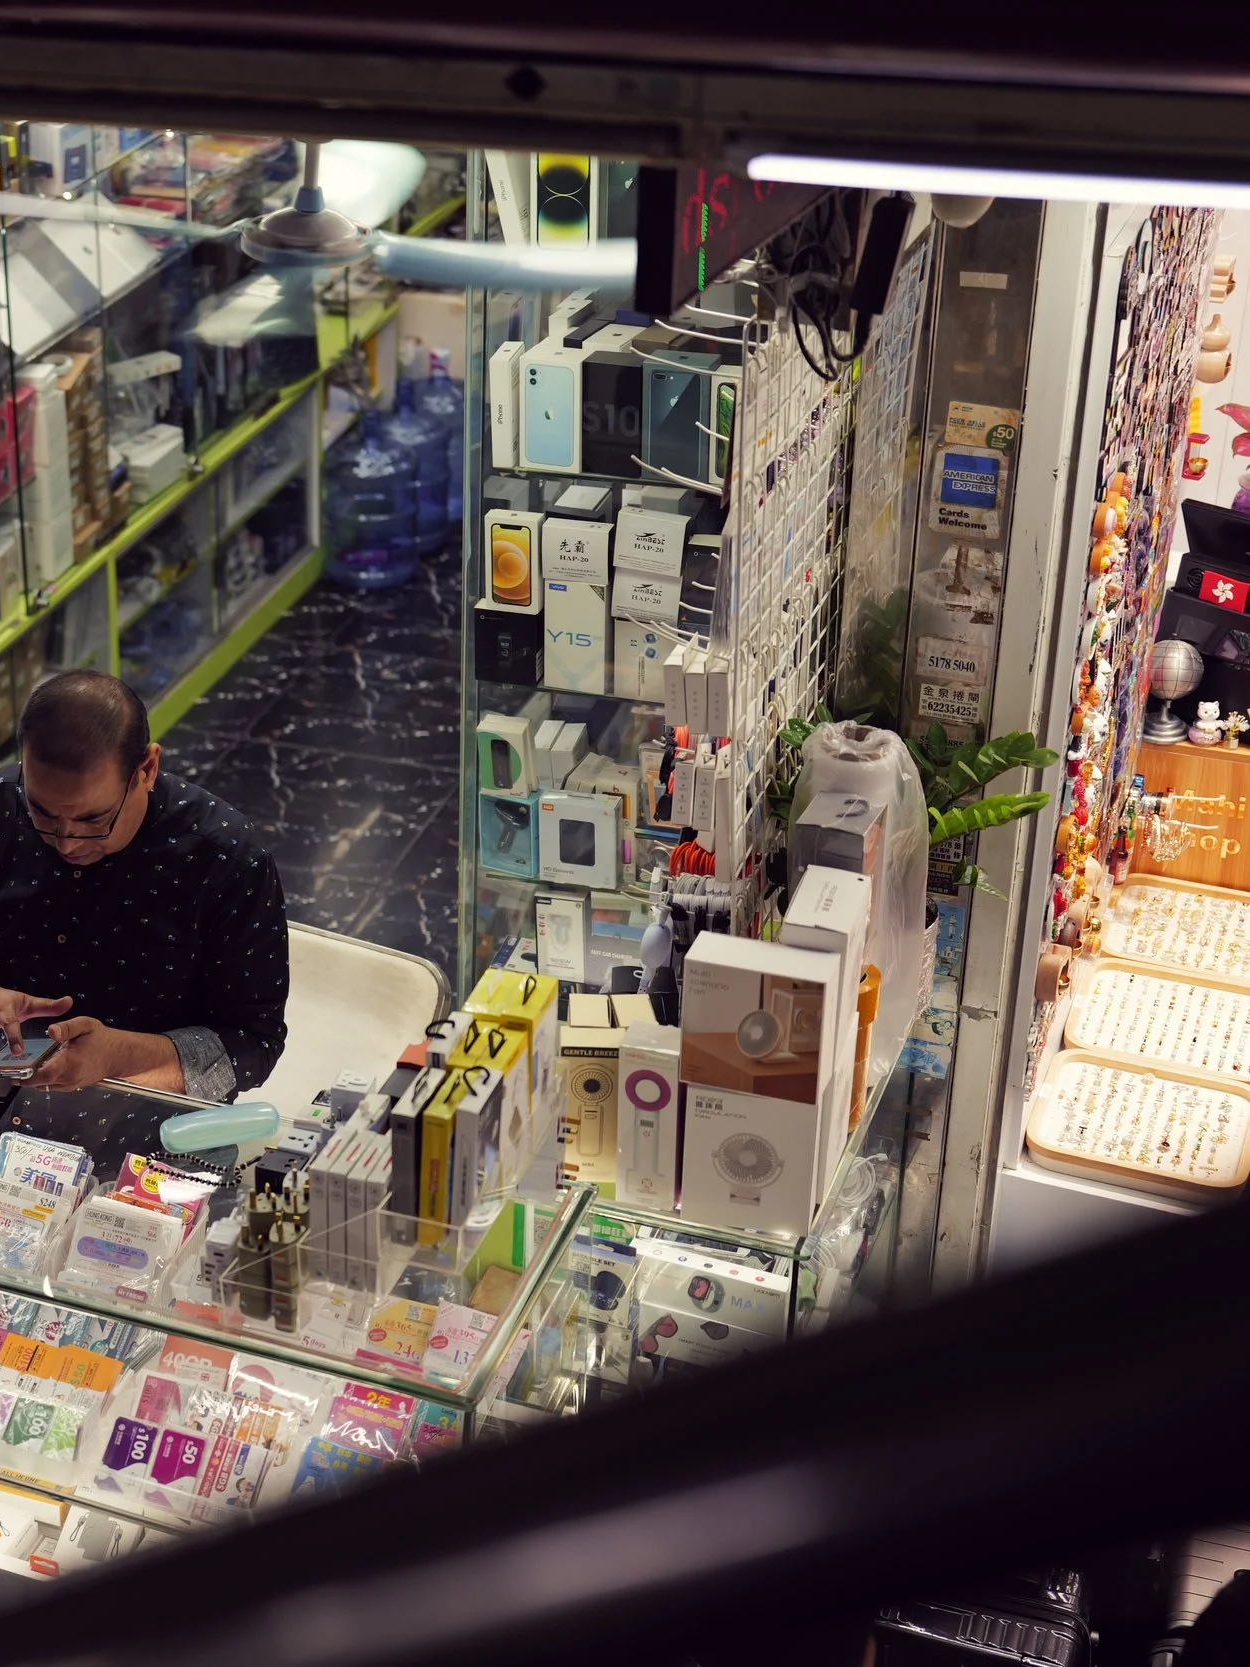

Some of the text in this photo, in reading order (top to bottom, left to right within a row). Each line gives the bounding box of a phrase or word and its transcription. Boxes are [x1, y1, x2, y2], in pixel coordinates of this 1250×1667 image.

[584, 402, 641, 438] S10
[942, 470, 994, 484] AMERICAN
[952, 481, 996, 493] EXPRESS
[939, 507, 969, 518] Cards
[938, 517, 987, 530] Welcome
[634, 543, 664, 553] HAP-20
[559, 554, 589, 563] HAP-20
[631, 595, 661, 605] HAP-20
[928, 656, 976, 673] 5178 5040
[927, 701, 971, 717] 62235425
[553, 867, 575, 875] Elements
[563, 1048, 594, 1057] GENTLE
[43, 1145, 56, 1153] USA
[36, 1154, 52, 1165] 5G
[40, 1197, 57, 1209] $248
[86, 1211, 114, 1223] HONG KONG
[117, 1288, 146, 1302] MY FRIEND
[310, 1338, 327, 1350] days
[16, 1347, 34, 1373] $100
[70, 1363, 87, 1388] $50
[367, 1391, 392, 1408] 2年
[131, 1426, 149, 1461] $100
[182, 1440, 199, 1465] $50
[1, 1470, 15, 1478] ALL
[25, 1475, 41, 1484] ONE
